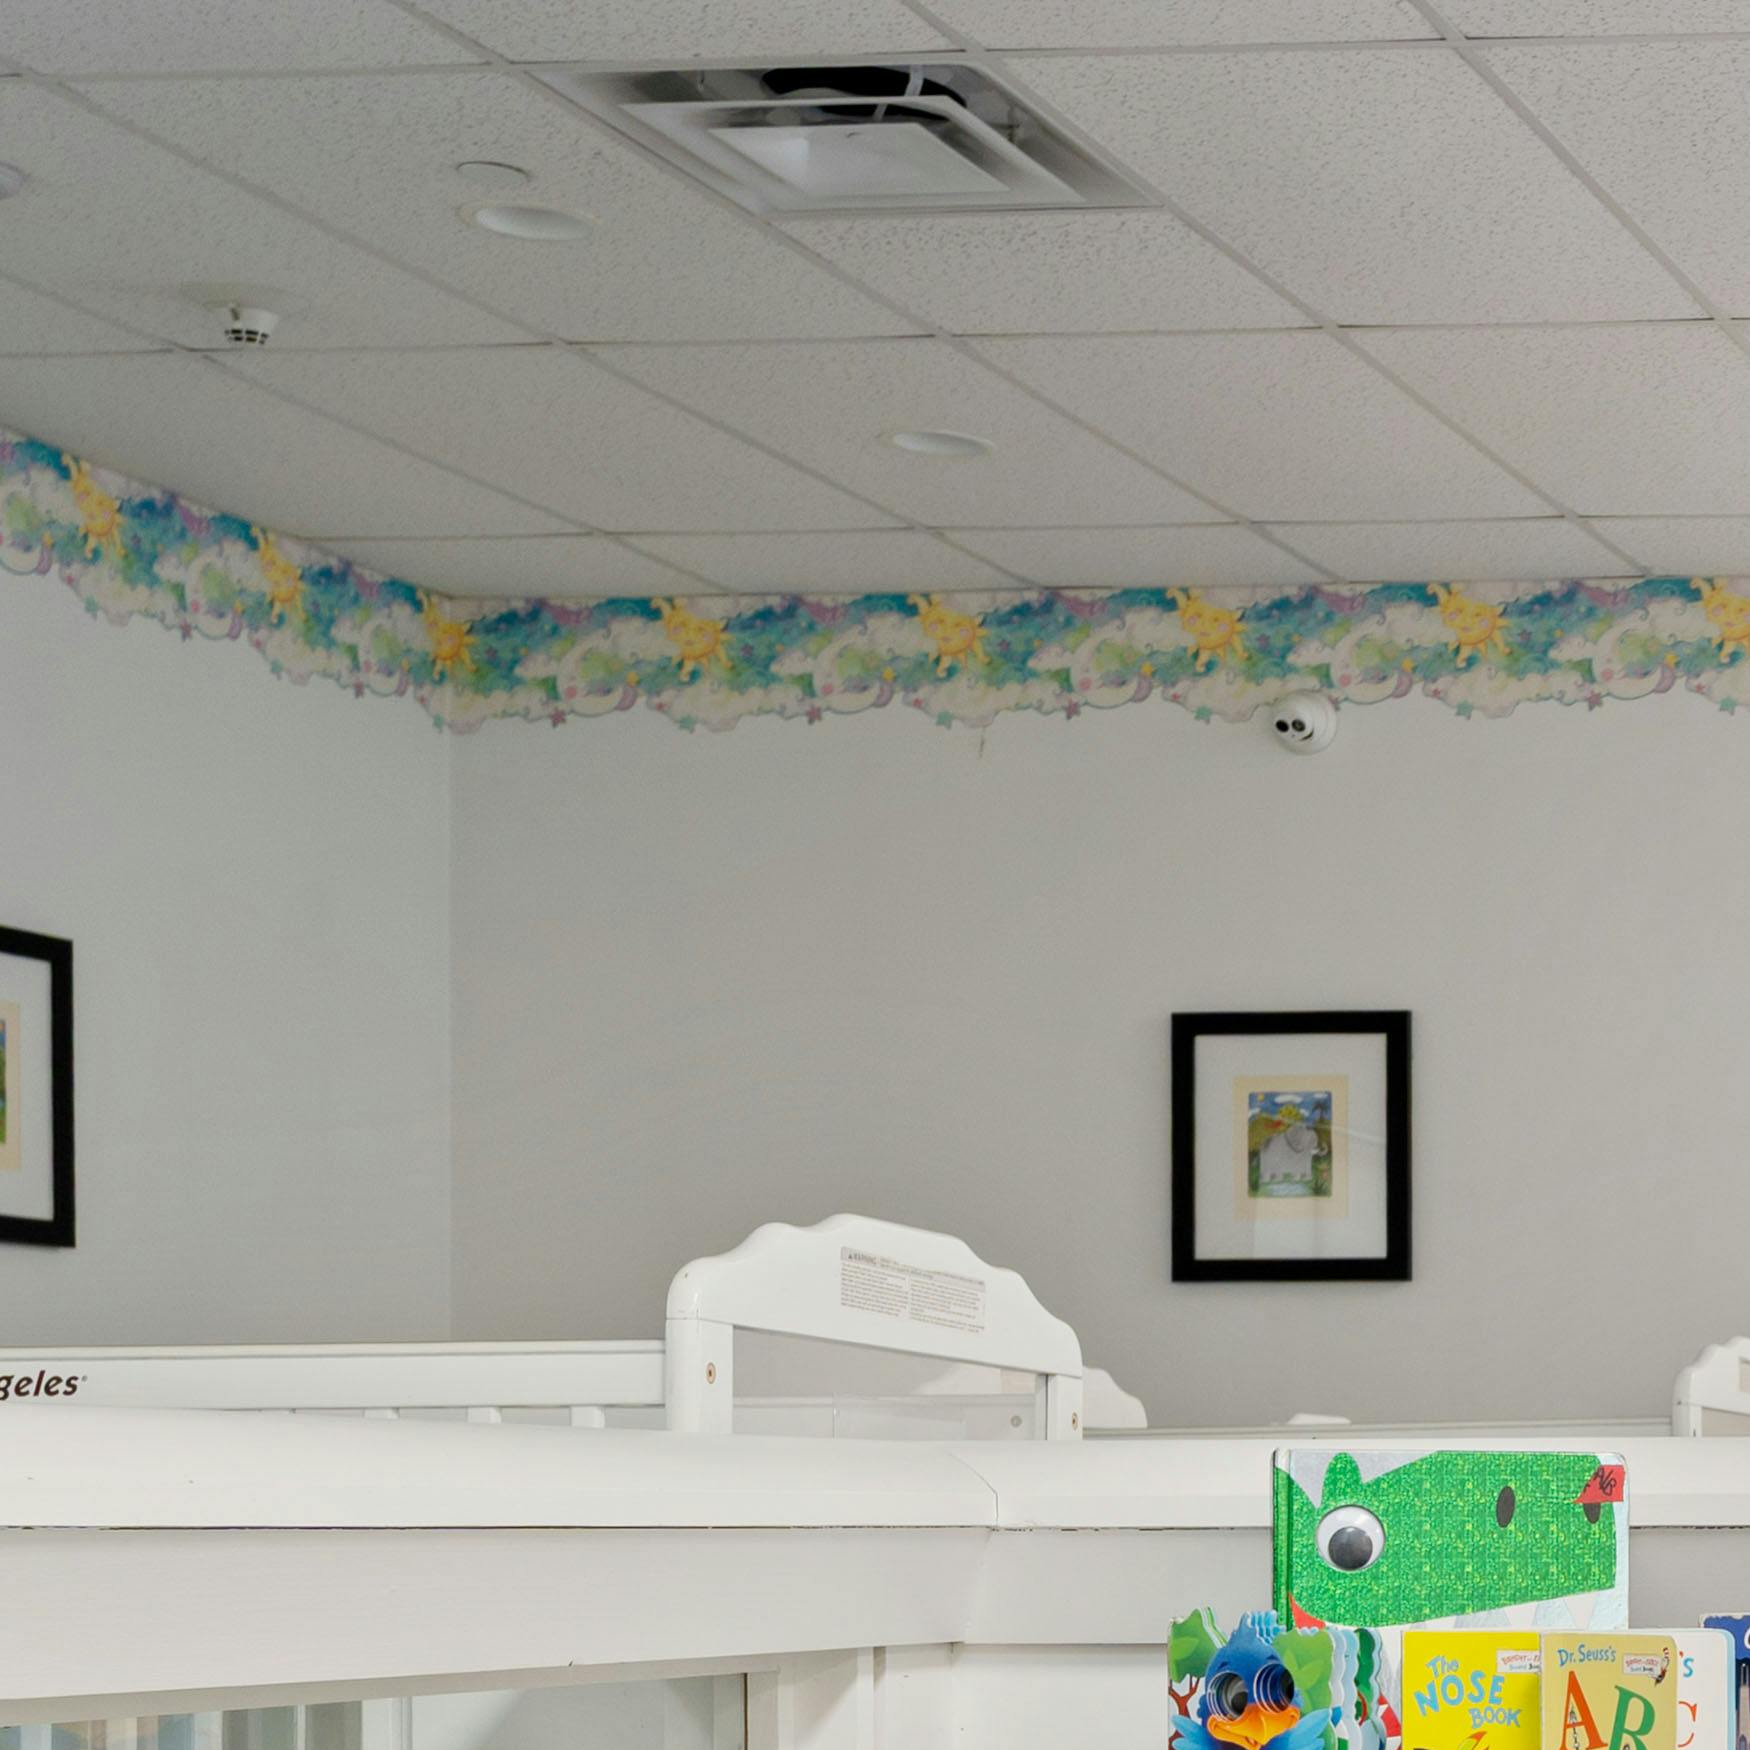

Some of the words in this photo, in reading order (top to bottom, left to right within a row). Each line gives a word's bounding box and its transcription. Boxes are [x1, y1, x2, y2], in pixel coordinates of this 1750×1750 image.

[1425, 1655, 1460, 1679] The
[1557, 1648, 1577, 1668] Dr.
[1577, 1643, 1617, 1663] Seuss's
[1413, 1669, 1505, 1718] NOSE
[1468, 1706, 1523, 1730] BOOK
